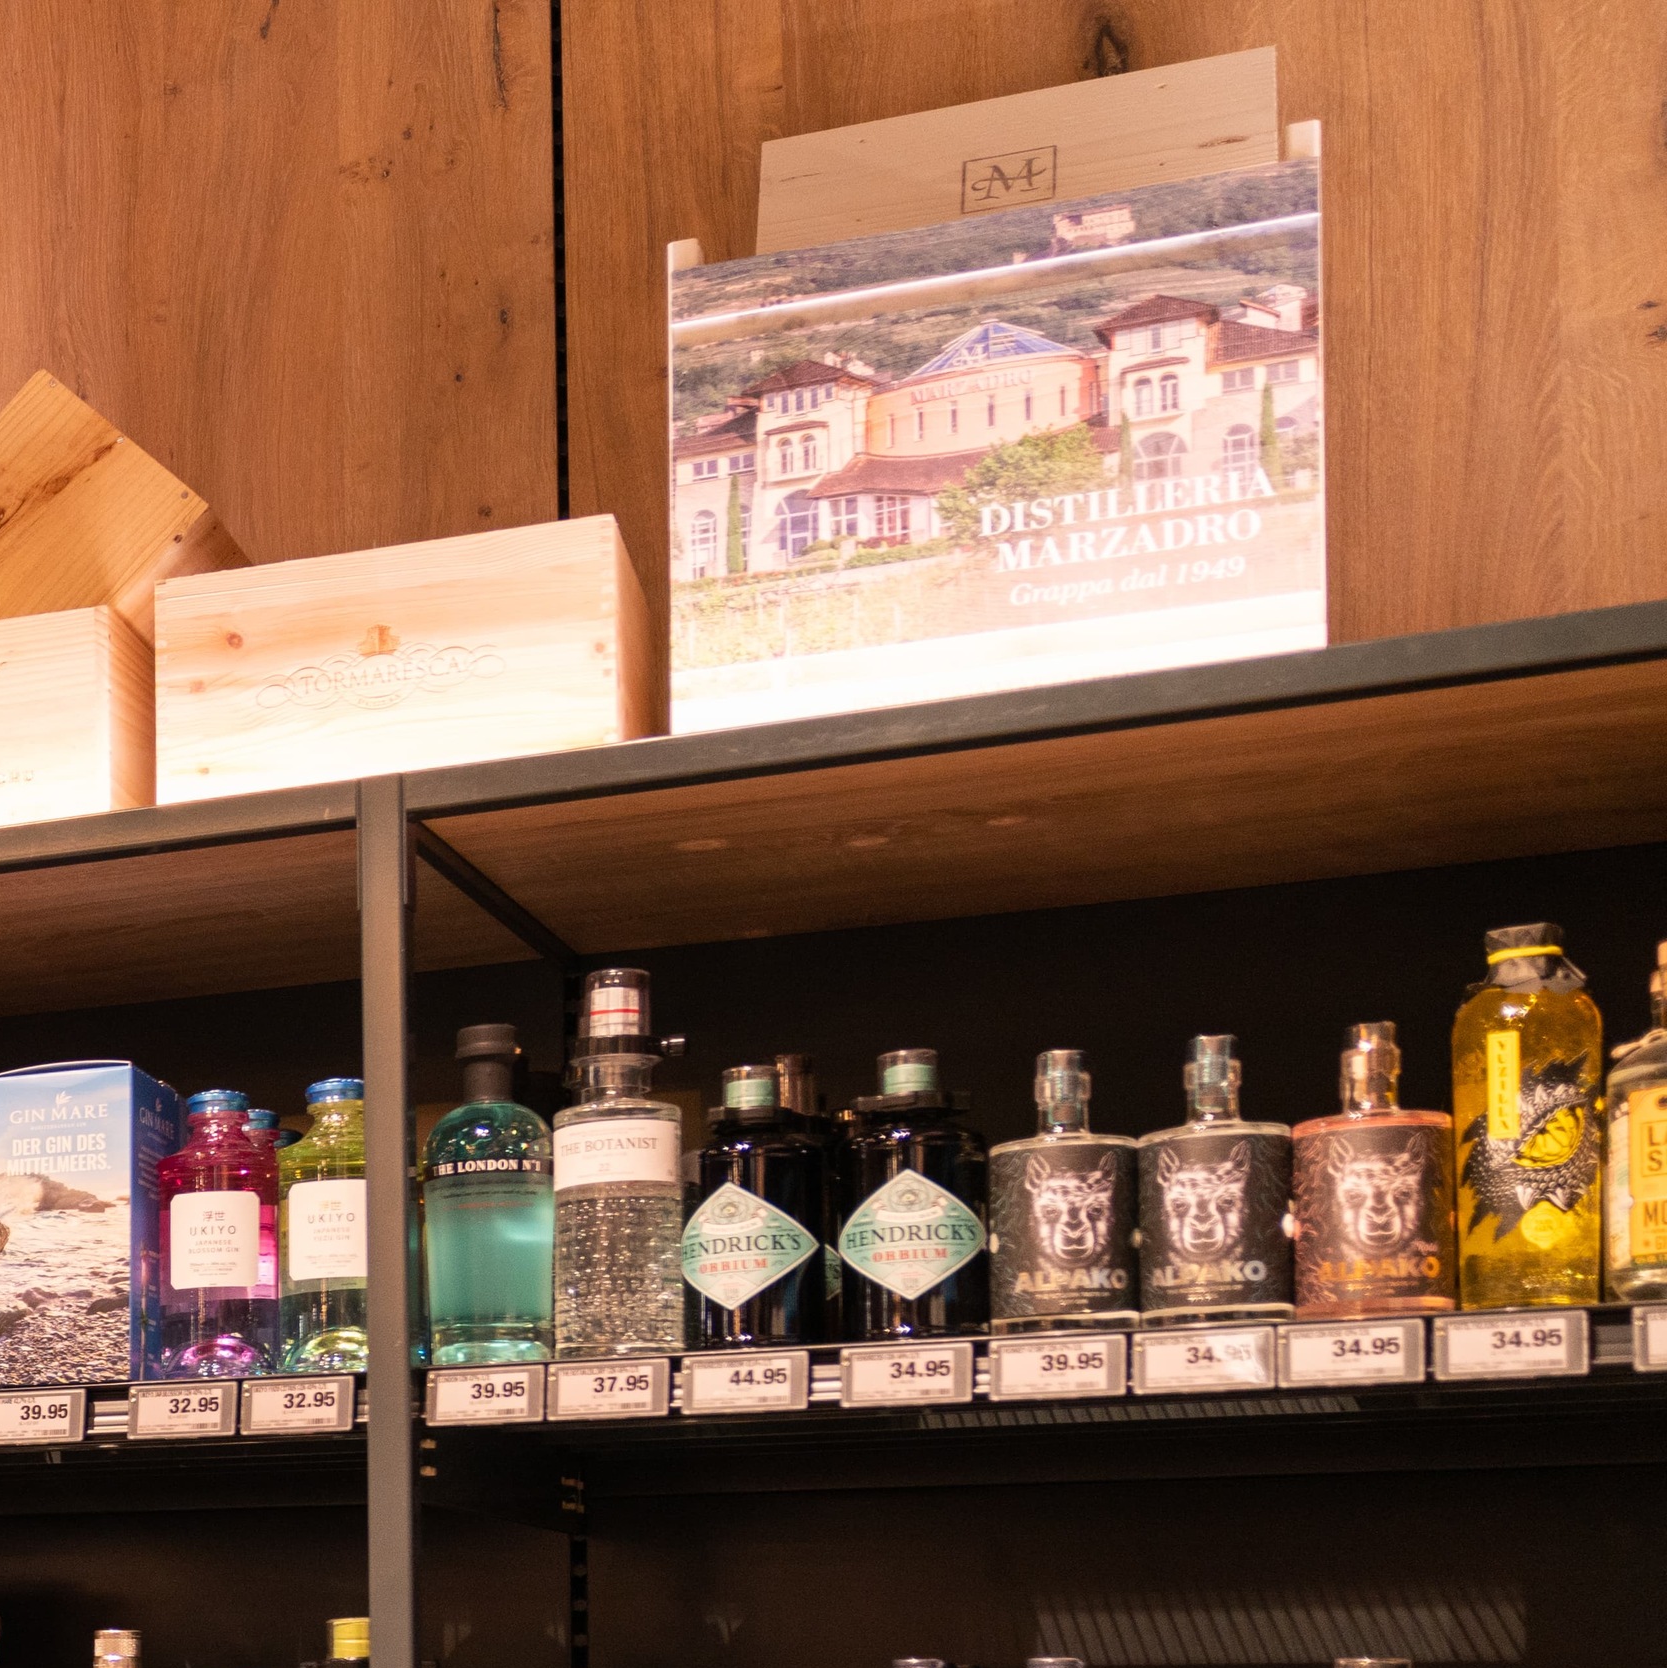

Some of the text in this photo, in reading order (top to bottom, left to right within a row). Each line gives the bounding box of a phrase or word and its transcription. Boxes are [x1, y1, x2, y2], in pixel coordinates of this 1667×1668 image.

[980, 468, 1276, 537] DISTILLERIA
[996, 508, 1262, 573] MARZADRO
[1009, 557, 1246, 609] Grappa dal 1949
[298, 656, 468, 697] TORMARESCA
[10, 1102, 109, 1124] GIN MARE
[12, 1133, 106, 1157] DER GIN DES
[585, 1136, 657, 1154] BOTANIST
[6, 1153, 112, 1177] MITTELMEERS.
[457, 1159, 517, 1174] LONDON
[307, 1212, 356, 1224] UKIYO
[190, 1225, 237, 1237] UKIYO
[846, 1222, 977, 1249] HENDRICK'S
[699, 1257, 768, 1275] ORBIUM
[872, 1247, 948, 1263] ORBIUM
[1153, 1260, 1267, 1288] ALPAKO
[1317, 1255, 1441, 1283] ALPAKO
[1016, 1269, 1128, 1293] ALPAKO
[1331, 1336, 1401, 1358] 34.95
[1491, 1327, 1563, 1350] 34.95
[730, 1367, 788, 1387] 44.95
[889, 1359, 951, 1379] 34.95
[470, 1381, 526, 1400] 39.95
[593, 1374, 649, 1394] 37.95
[169, 1397, 219, 1415] 32.95
[284, 1392, 335, 1410] 32.95
